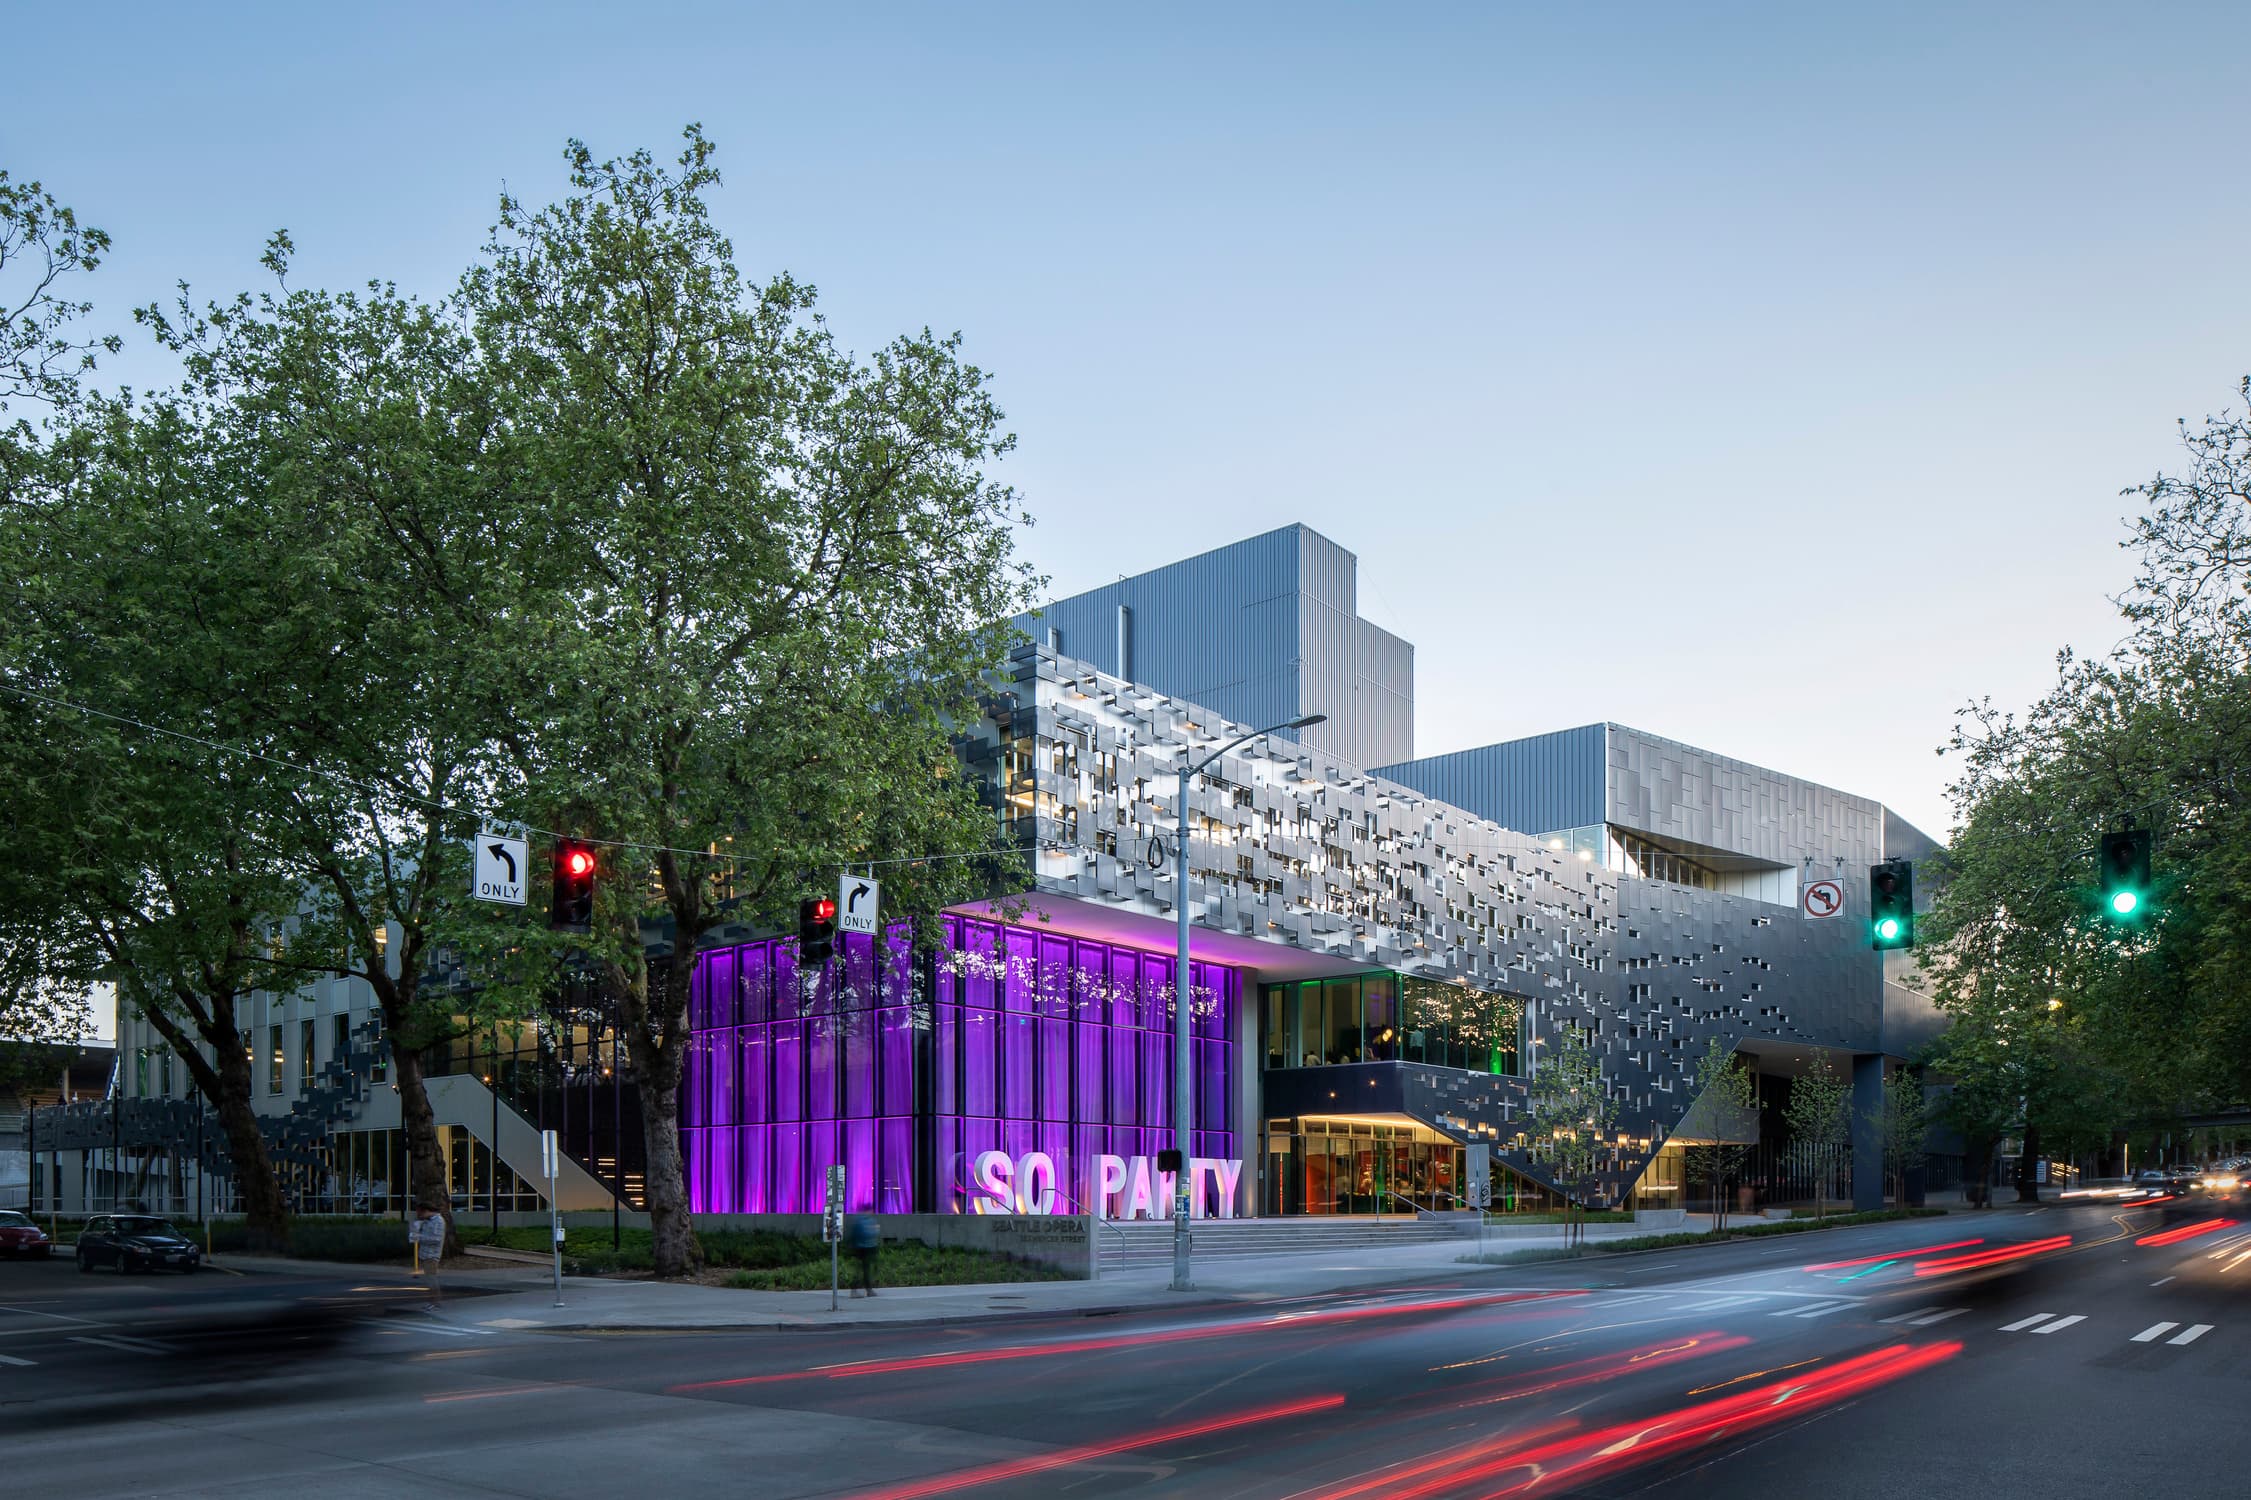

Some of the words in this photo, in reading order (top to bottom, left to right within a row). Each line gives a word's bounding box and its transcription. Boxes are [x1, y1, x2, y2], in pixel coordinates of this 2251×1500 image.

[481, 882, 520, 899] ONLY
[844, 915, 872, 929] ONLY
[974, 1151, 1056, 1216] SO
[992, 1219, 1040, 1232] SEATTLE
[1043, 1219, 1085, 1232] OPERA
